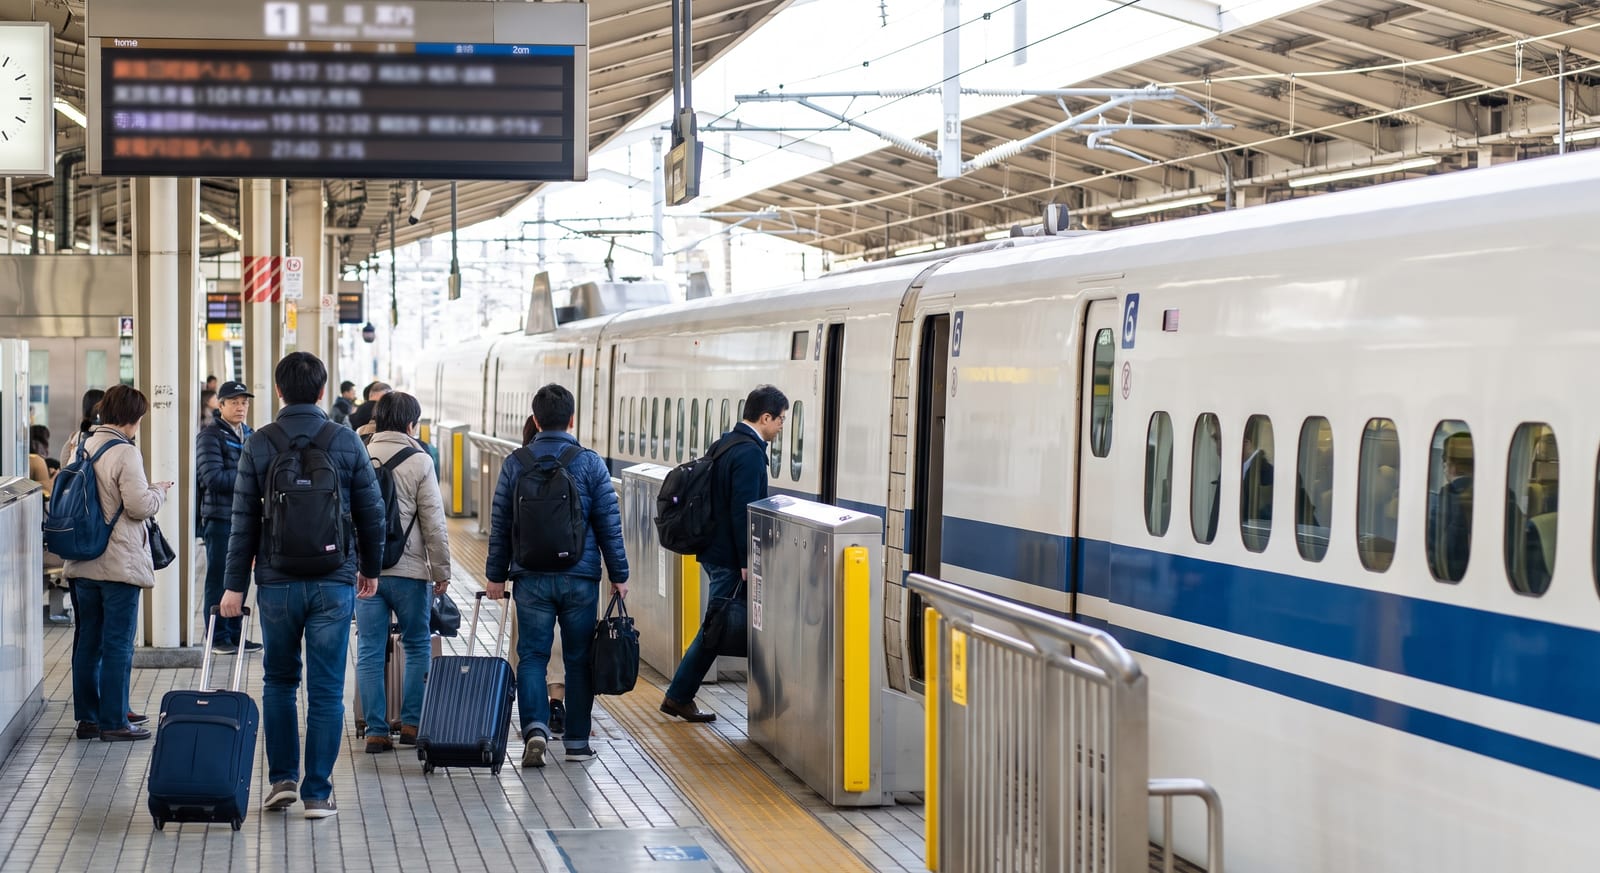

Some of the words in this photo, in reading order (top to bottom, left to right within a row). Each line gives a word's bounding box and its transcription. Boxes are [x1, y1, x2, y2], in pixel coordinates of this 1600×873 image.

[274, 7, 287, 31] 1
[954, 317, 961, 351] 6
[1125, 301, 1135, 342] 6
